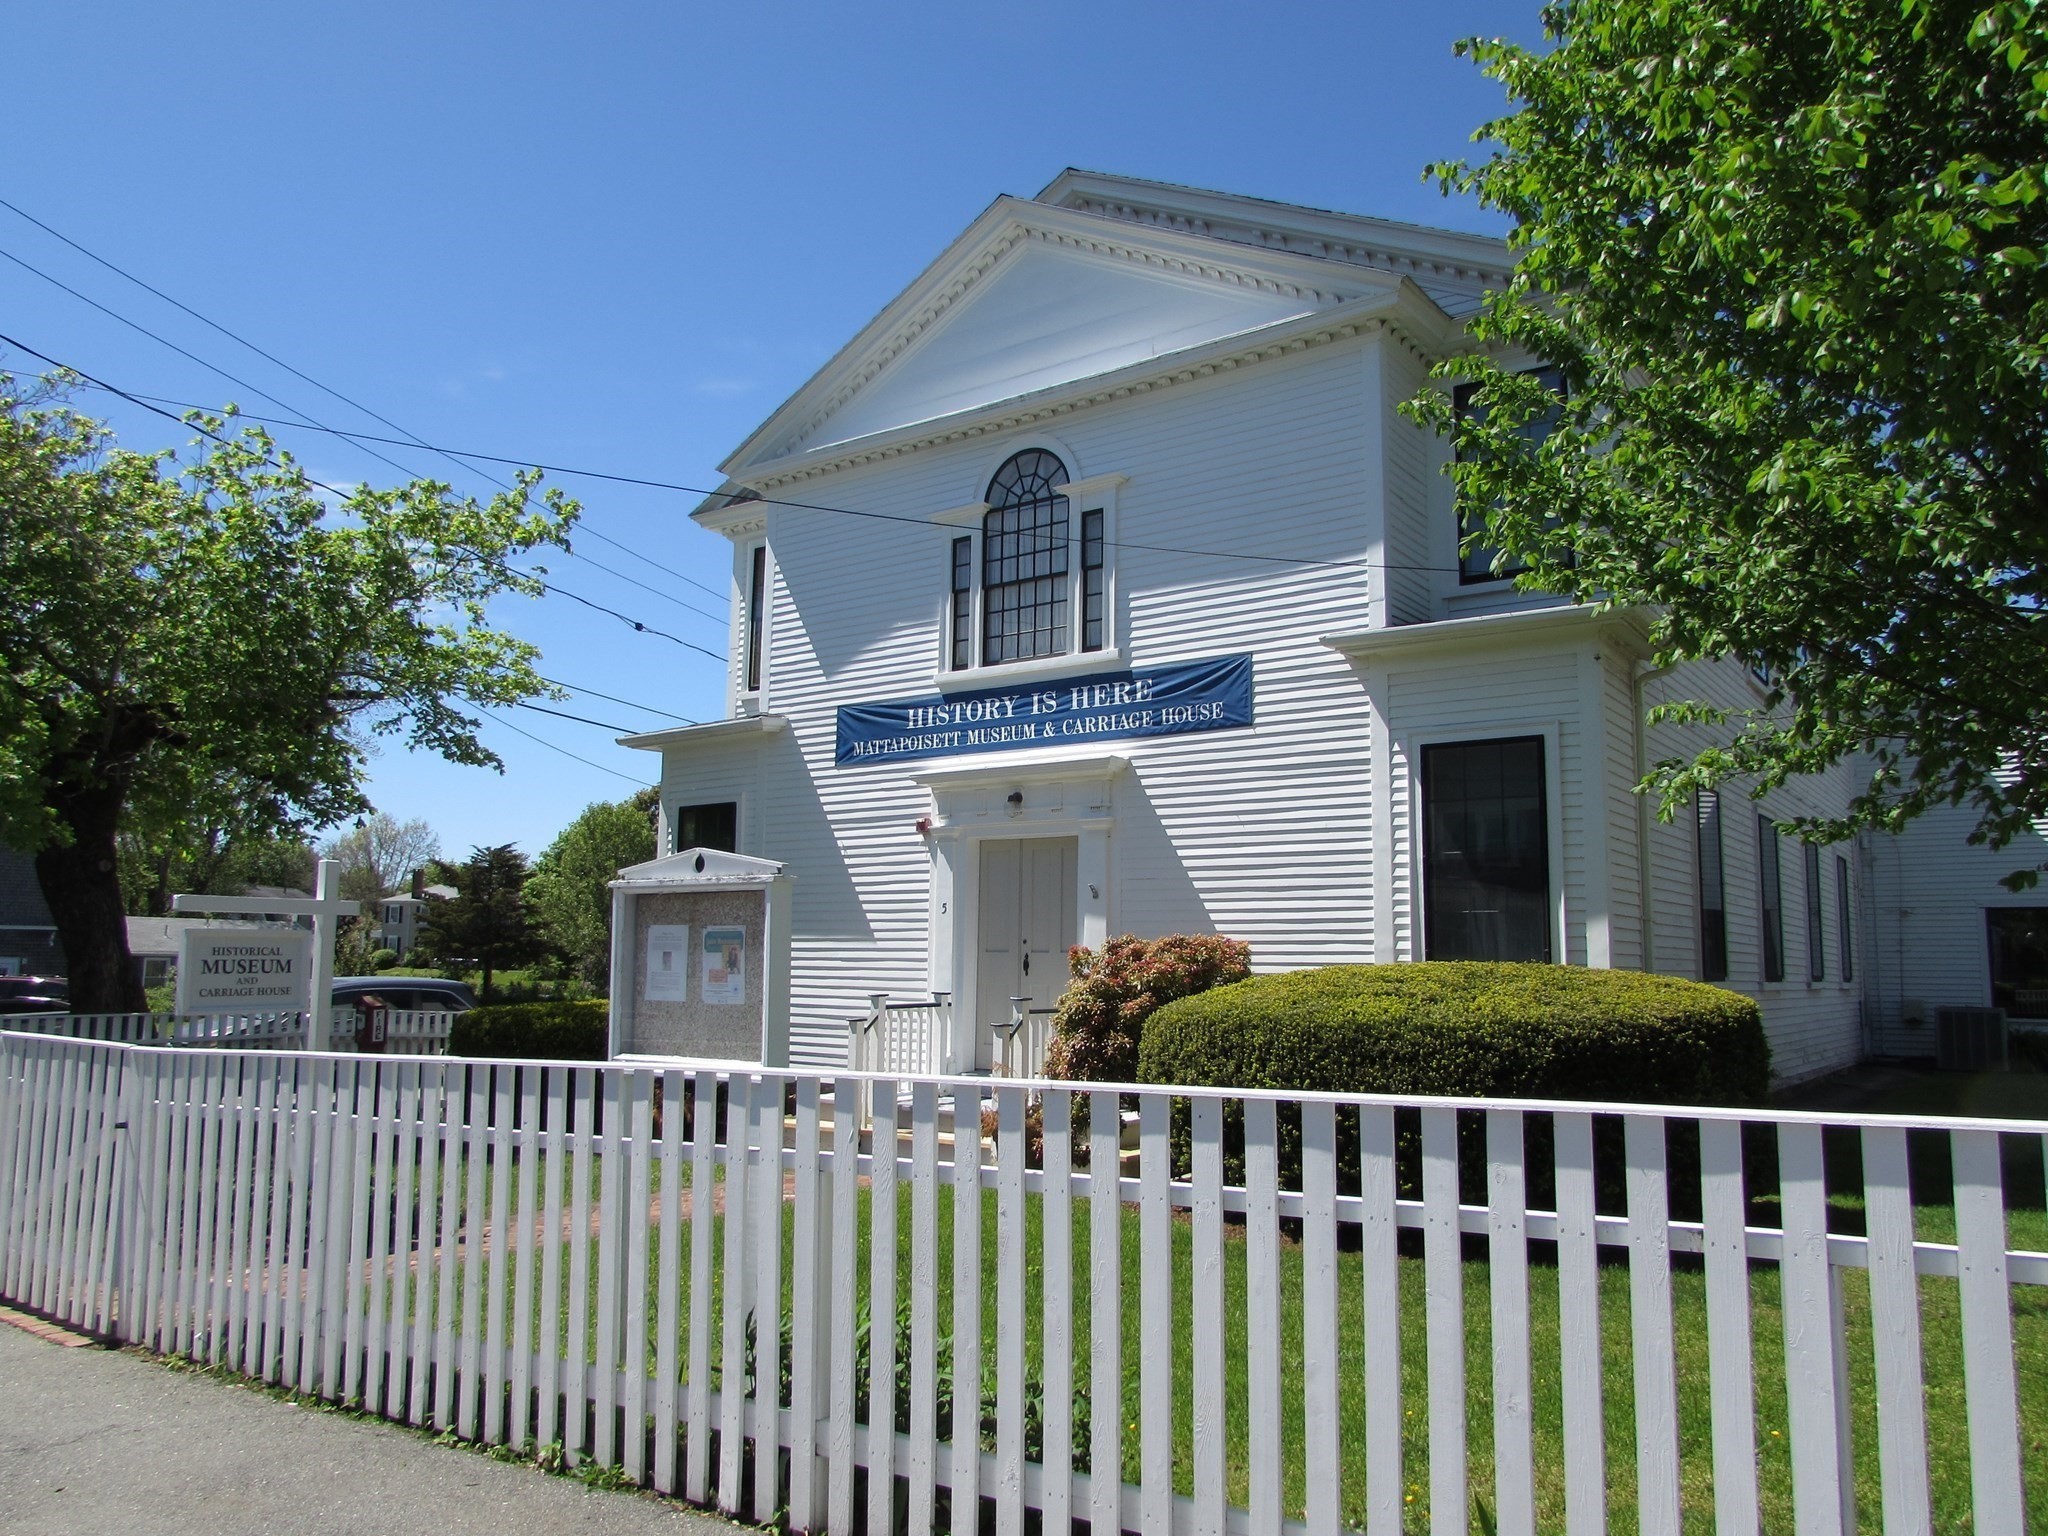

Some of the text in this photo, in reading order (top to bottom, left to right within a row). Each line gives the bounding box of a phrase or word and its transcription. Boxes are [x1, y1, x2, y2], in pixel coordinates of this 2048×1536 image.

[907, 678, 1153, 729] HISTORY IS HERE
[853, 701, 1224, 757] MATTAPOISETT MUSEUM & CARRIAGE HOUSE
[941, 903, 947, 914] 5
[212, 946, 282, 956] HISTORICAL
[201, 959, 292, 974] MUSEUM
[236, 977, 258, 985] AND
[199, 987, 292, 997] CARRIAGE HOUSE
